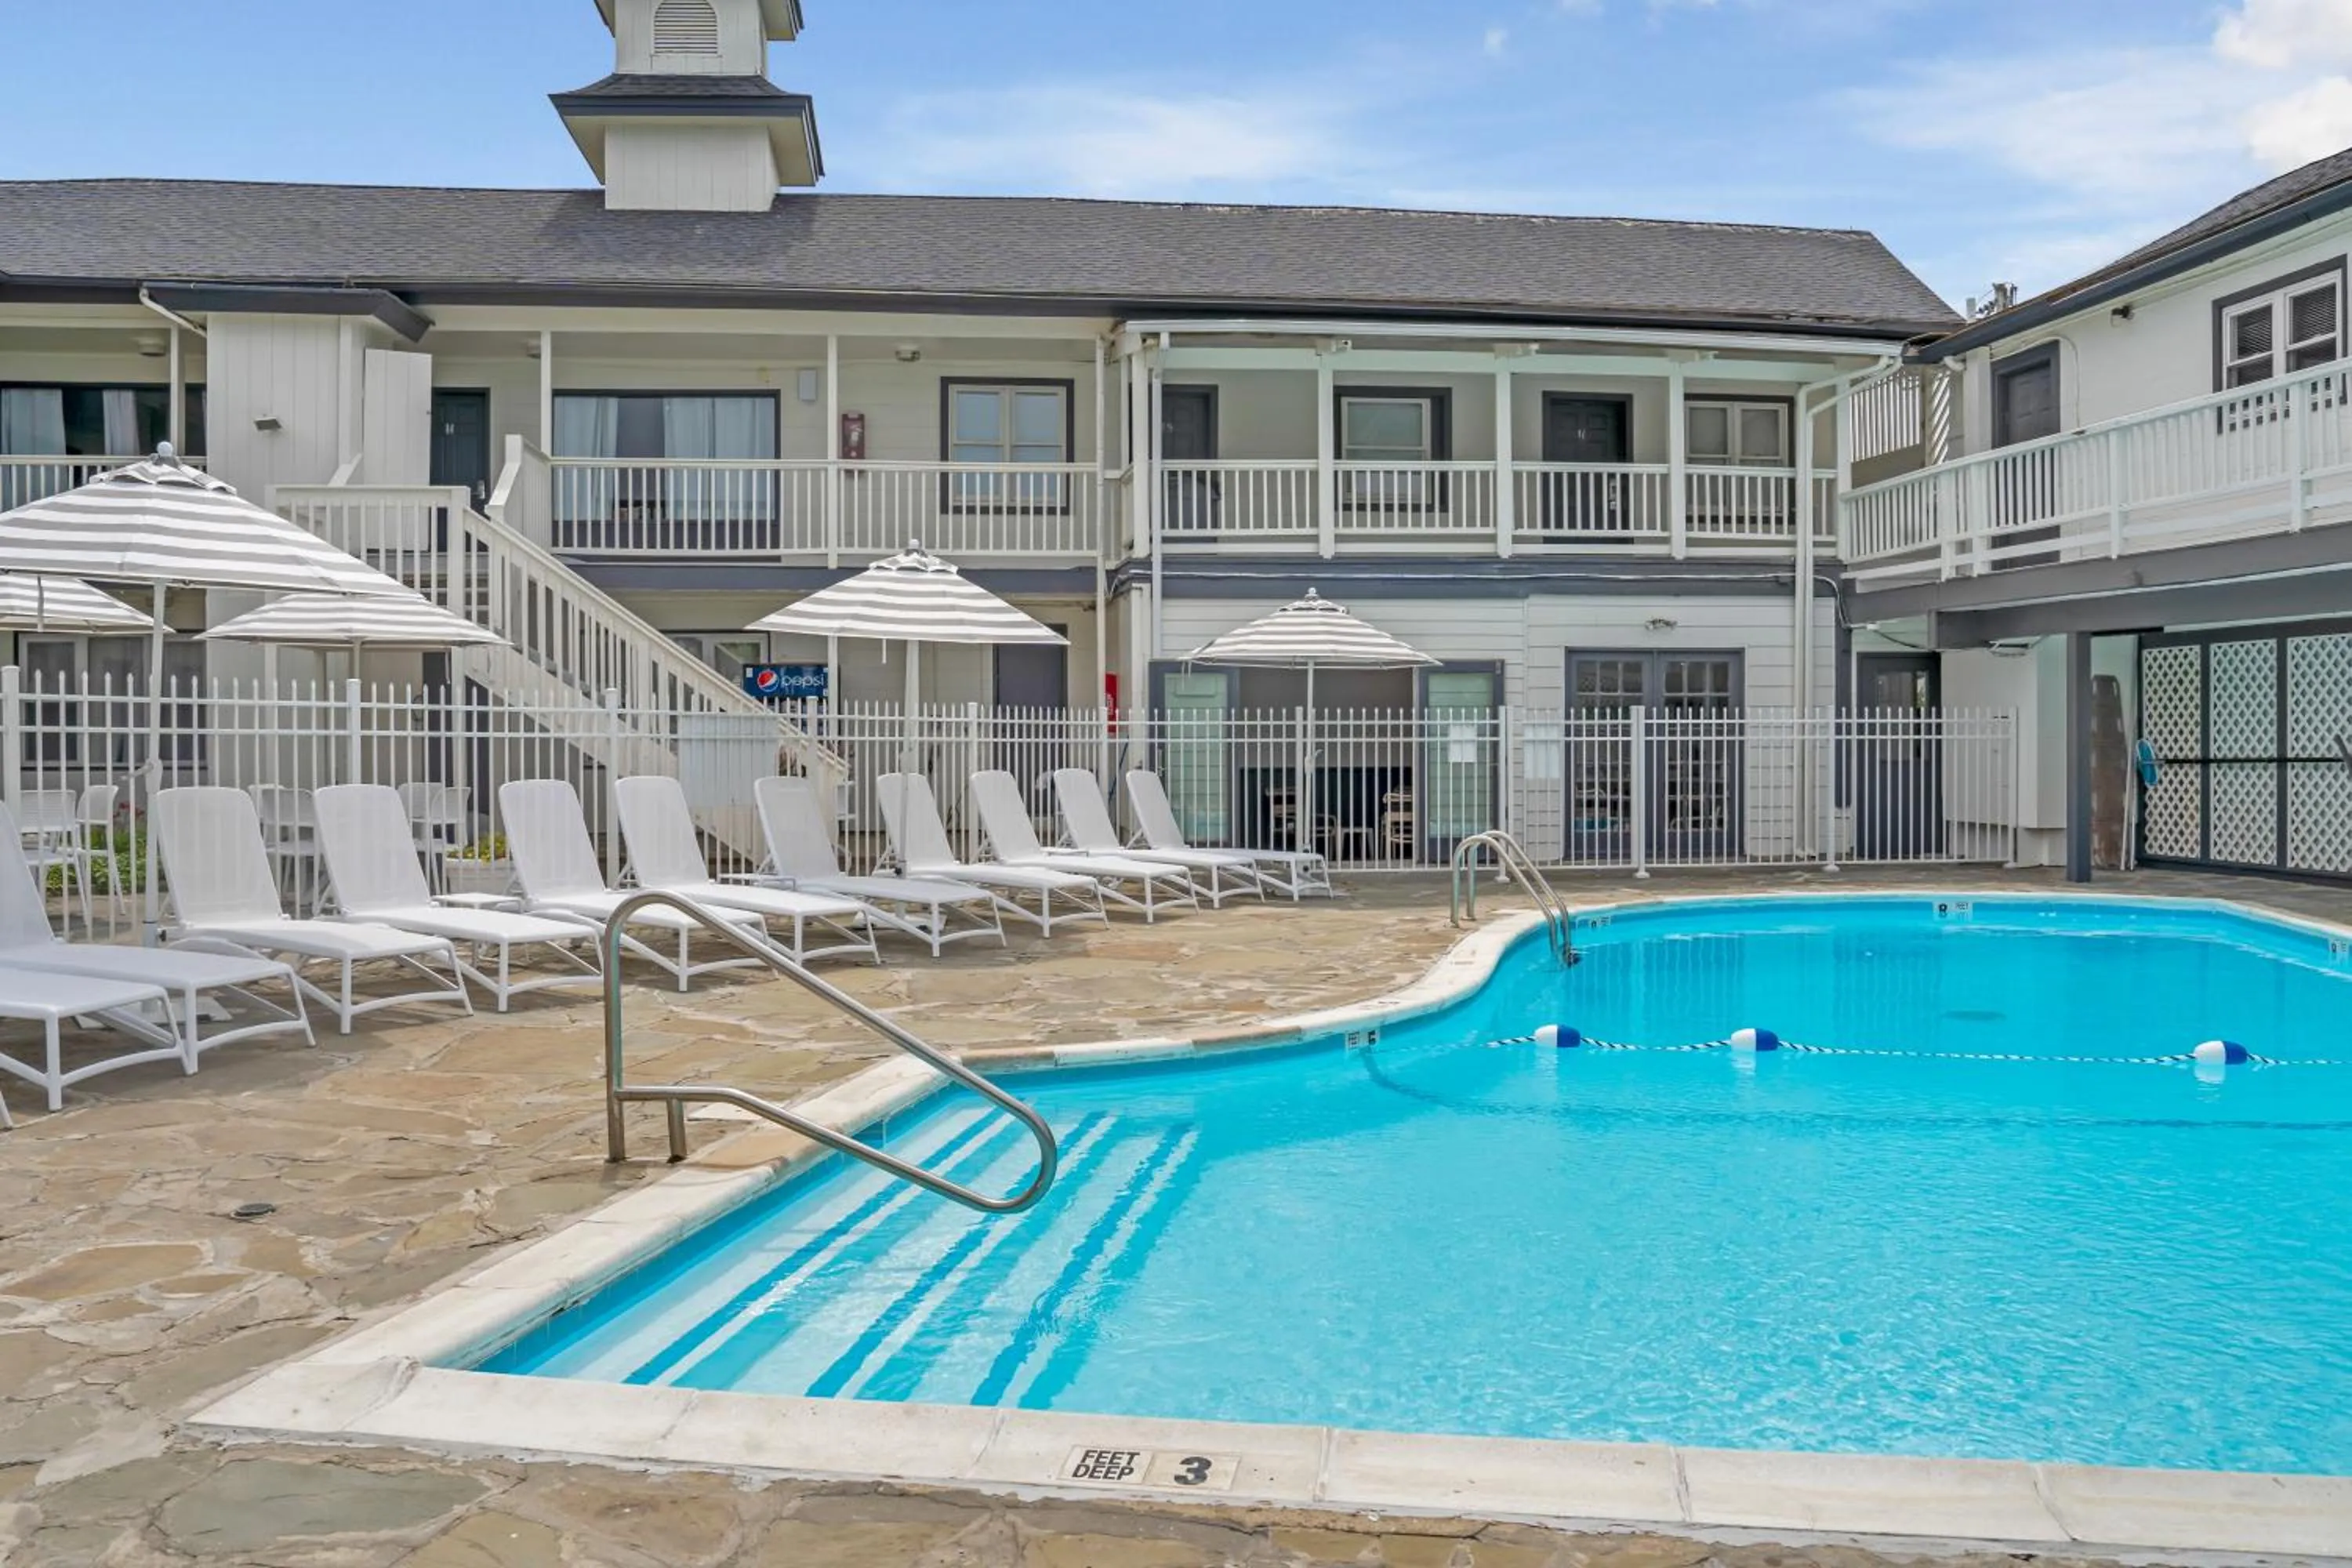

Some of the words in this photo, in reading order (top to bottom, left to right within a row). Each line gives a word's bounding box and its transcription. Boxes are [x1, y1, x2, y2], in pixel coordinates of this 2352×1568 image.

[781, 673, 824, 688] pepsi
[1080, 1450, 1140, 1466] FEET
[1071, 1464, 1134, 1481] DEEP
[1174, 1456, 1212, 1485] 3
